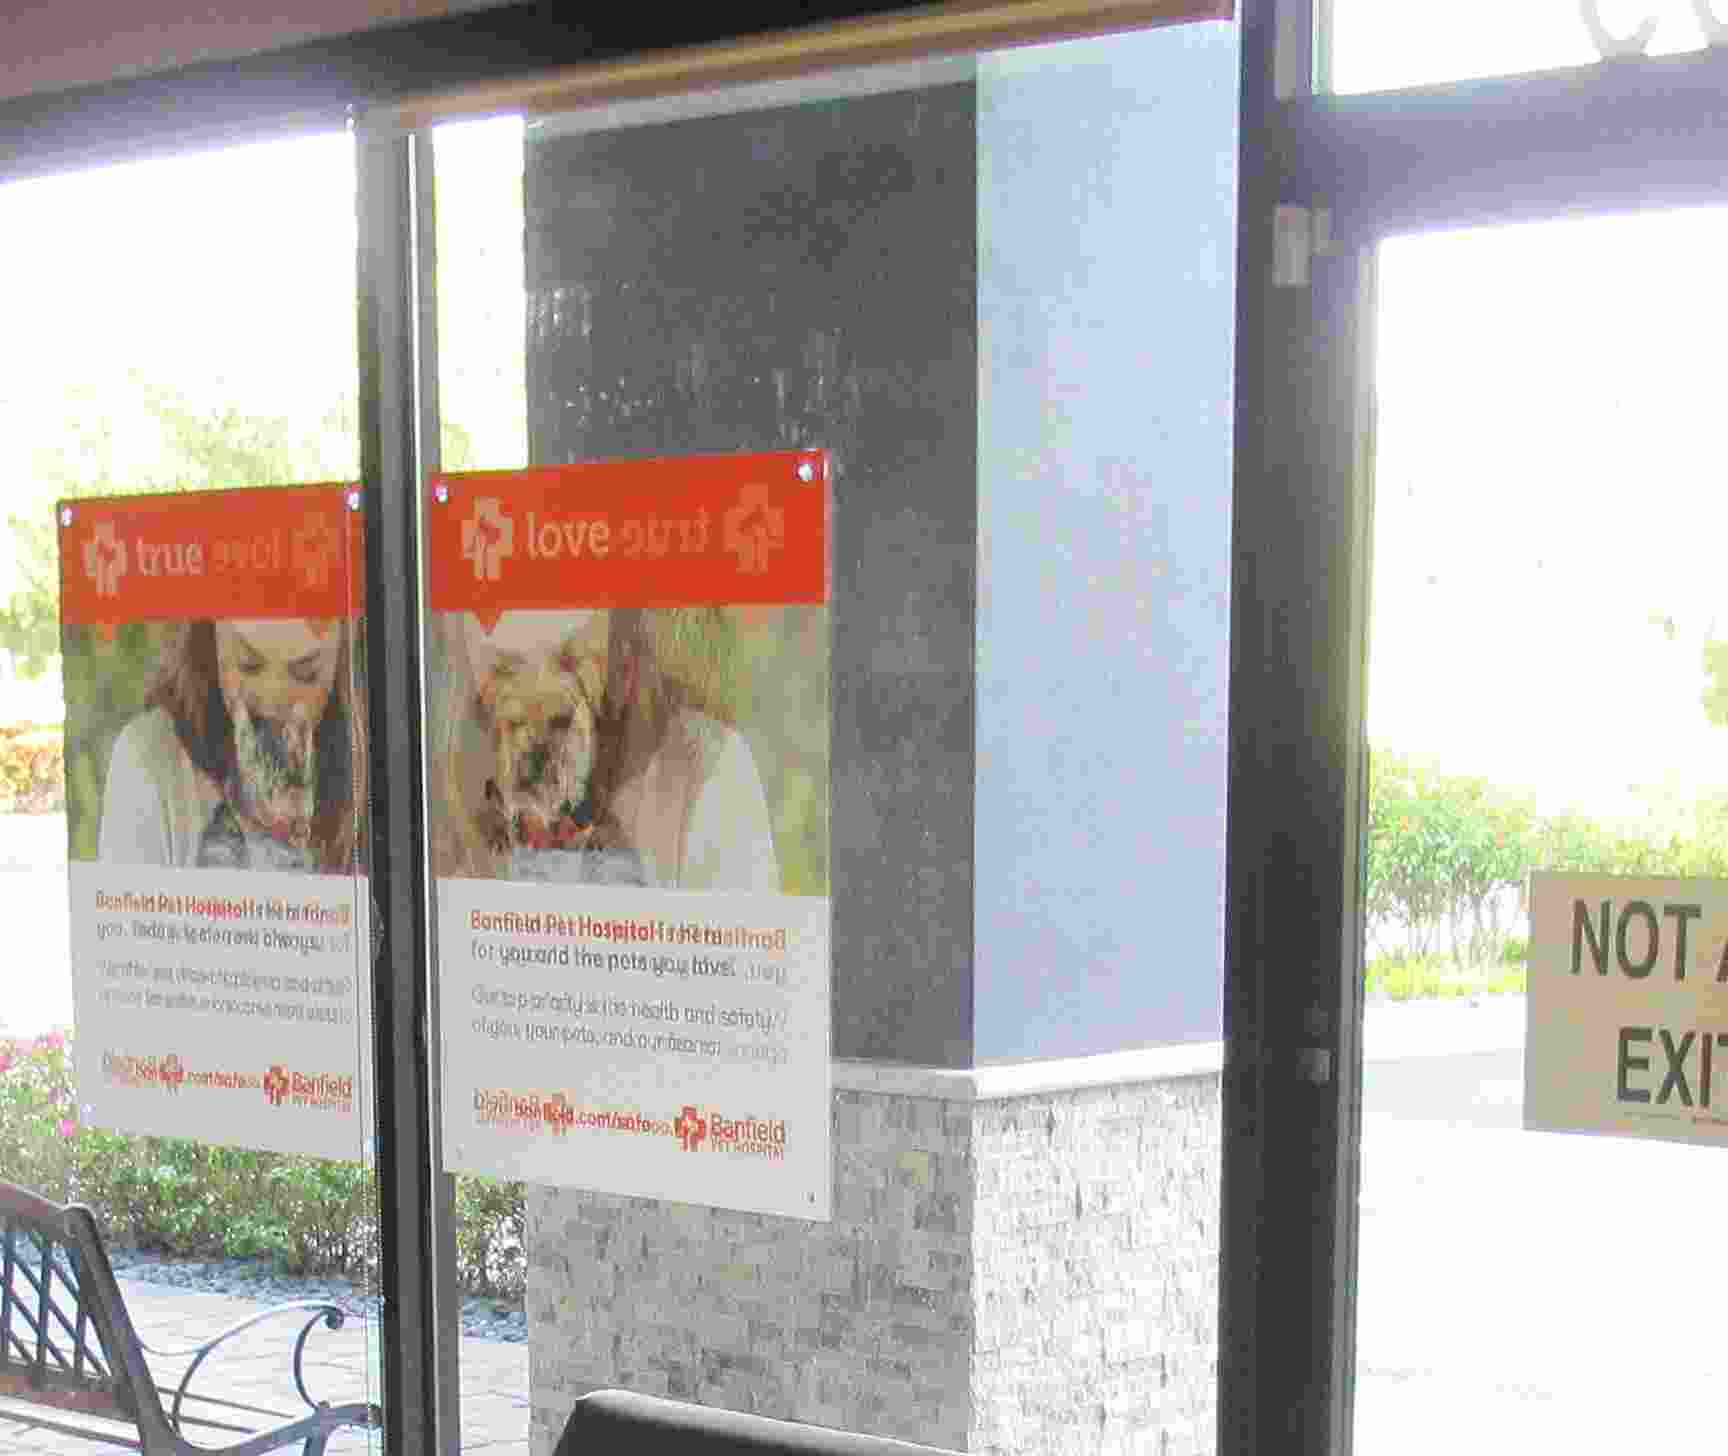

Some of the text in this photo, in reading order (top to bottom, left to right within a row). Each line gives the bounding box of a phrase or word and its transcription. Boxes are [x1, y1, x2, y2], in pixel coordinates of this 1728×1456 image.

[524, 509, 610, 560] love
[135, 537, 203, 577] true
[471, 910, 542, 935] Banfield
[545, 913, 576, 937] Pet
[578, 914, 656, 945] Hospital
[1570, 899, 1702, 984] NOT
[471, 938, 493, 961] for
[574, 946, 603, 968] the
[606, 952, 647, 977] pets
[648, 956, 683, 981] you
[292, 1072, 352, 1097] Banfield
[710, 1112, 786, 1145] Banfield
